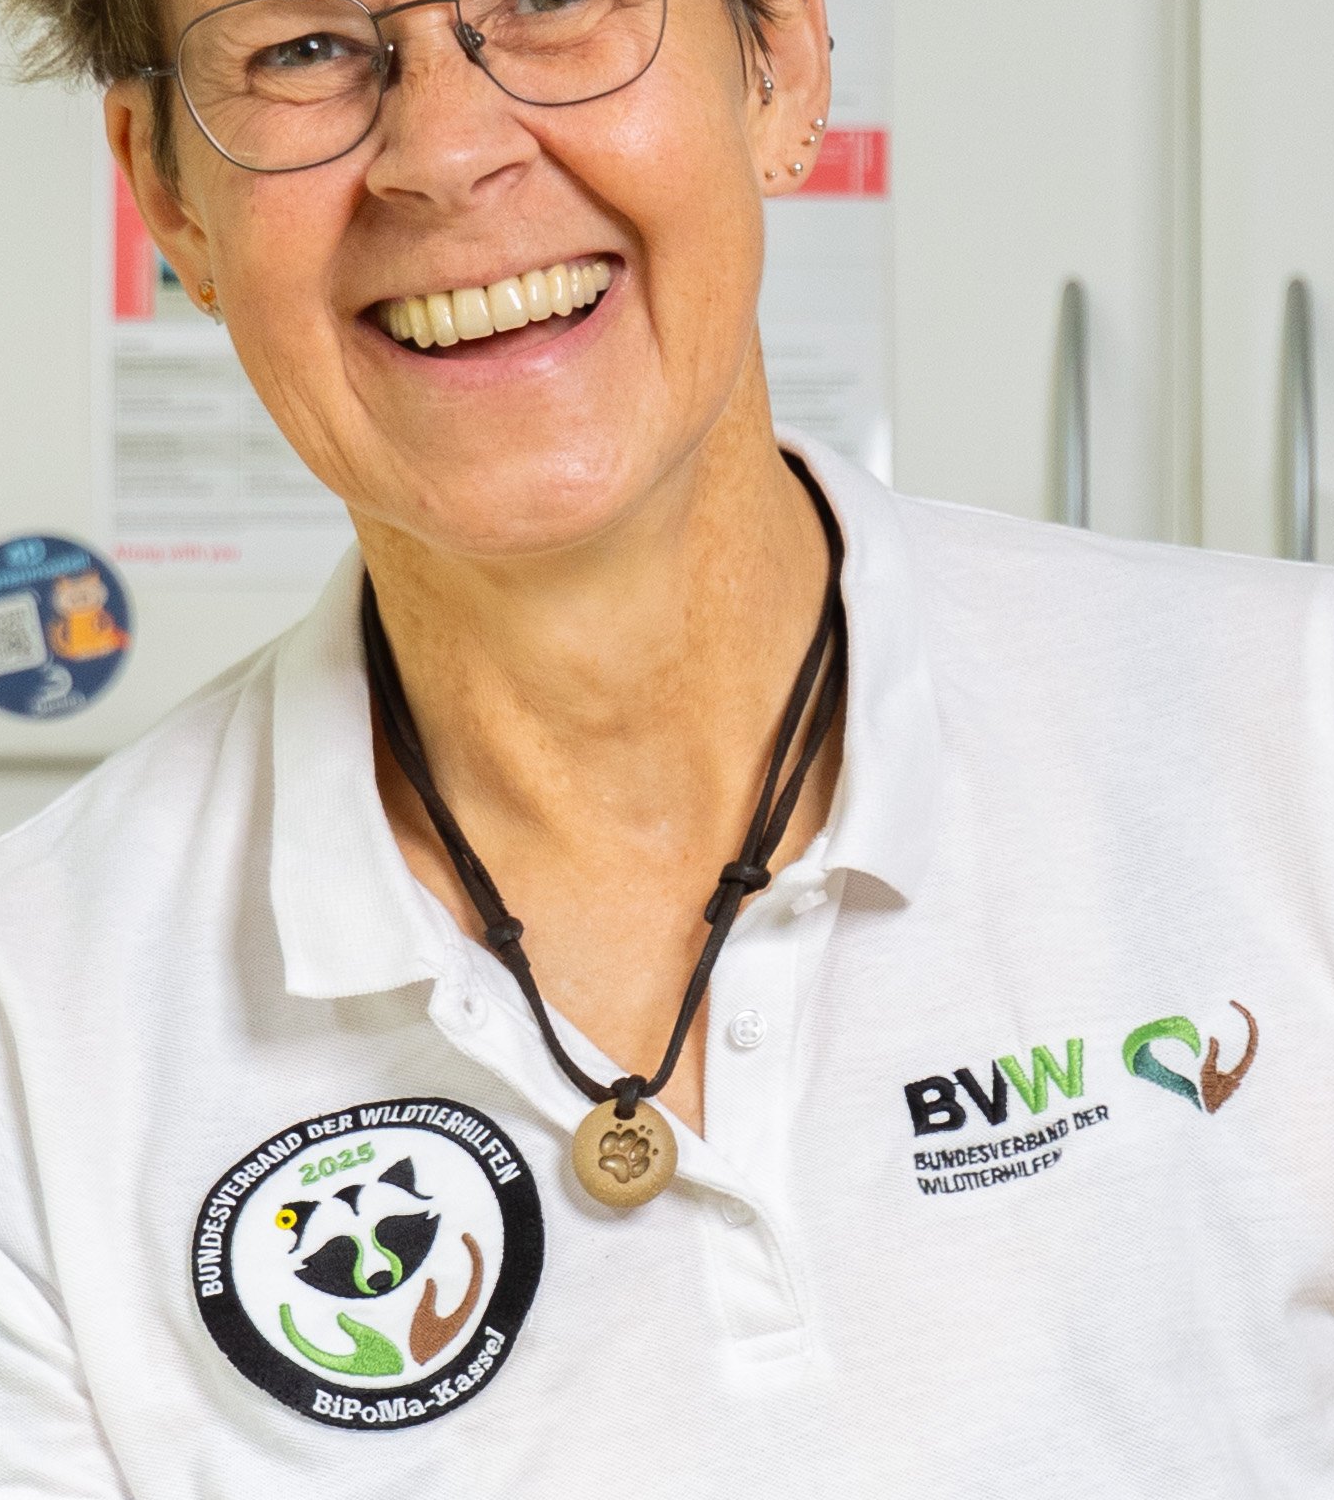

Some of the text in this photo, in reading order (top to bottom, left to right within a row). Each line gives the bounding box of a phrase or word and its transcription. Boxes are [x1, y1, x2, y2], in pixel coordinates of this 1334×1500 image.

[903, 1036, 1084, 1138] BVW
[298, 1140, 376, 1187] 2025
[913, 1104, 1110, 1172] BUNDESVERBAND DER
[196, 1103, 522, 1298] BUNDESVERBAND DER WILDTIERHILFEN
[312, 1325, 508, 1424] BiPoMa-Kassel
